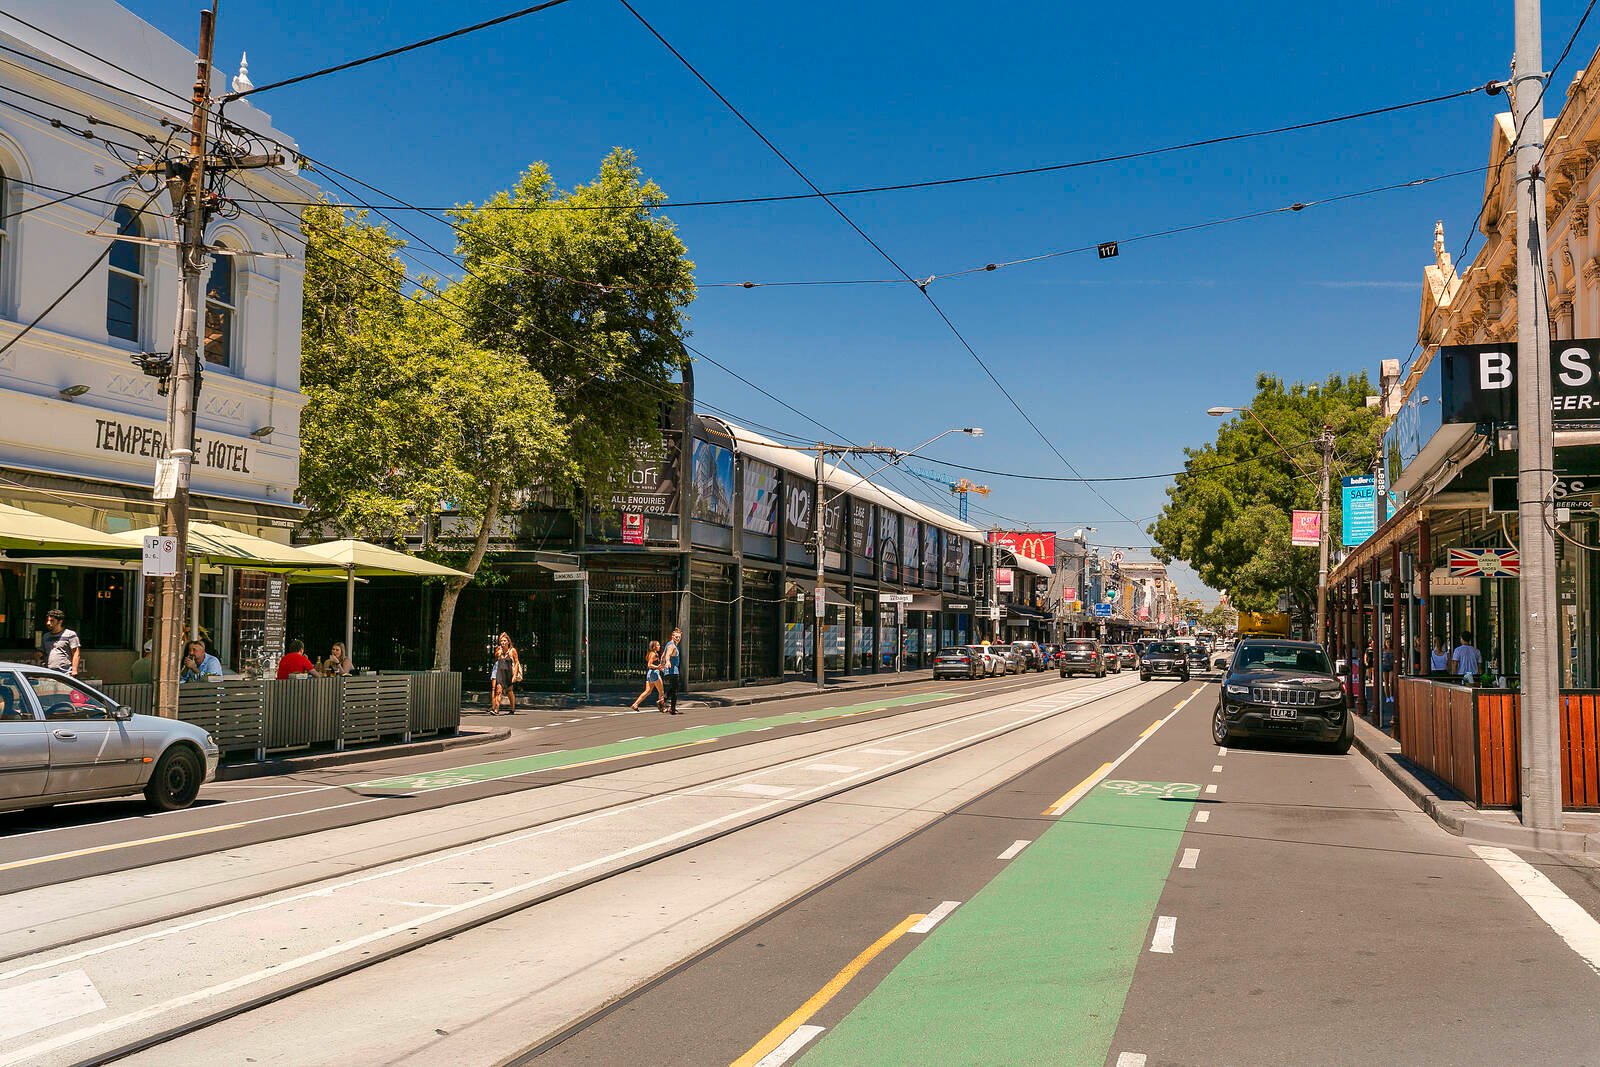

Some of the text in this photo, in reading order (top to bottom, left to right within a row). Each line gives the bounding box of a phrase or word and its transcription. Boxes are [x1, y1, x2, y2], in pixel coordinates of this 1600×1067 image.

[1100, 245, 1116, 256] 117
[1551, 395, 1600, 410] EER-
[96, 419, 250, 473] TEMPERE HOTEL
[611, 495, 626, 503] ALL
[628, 497, 666, 505] ENQUIRIES
[152, 539, 159, 549] P
